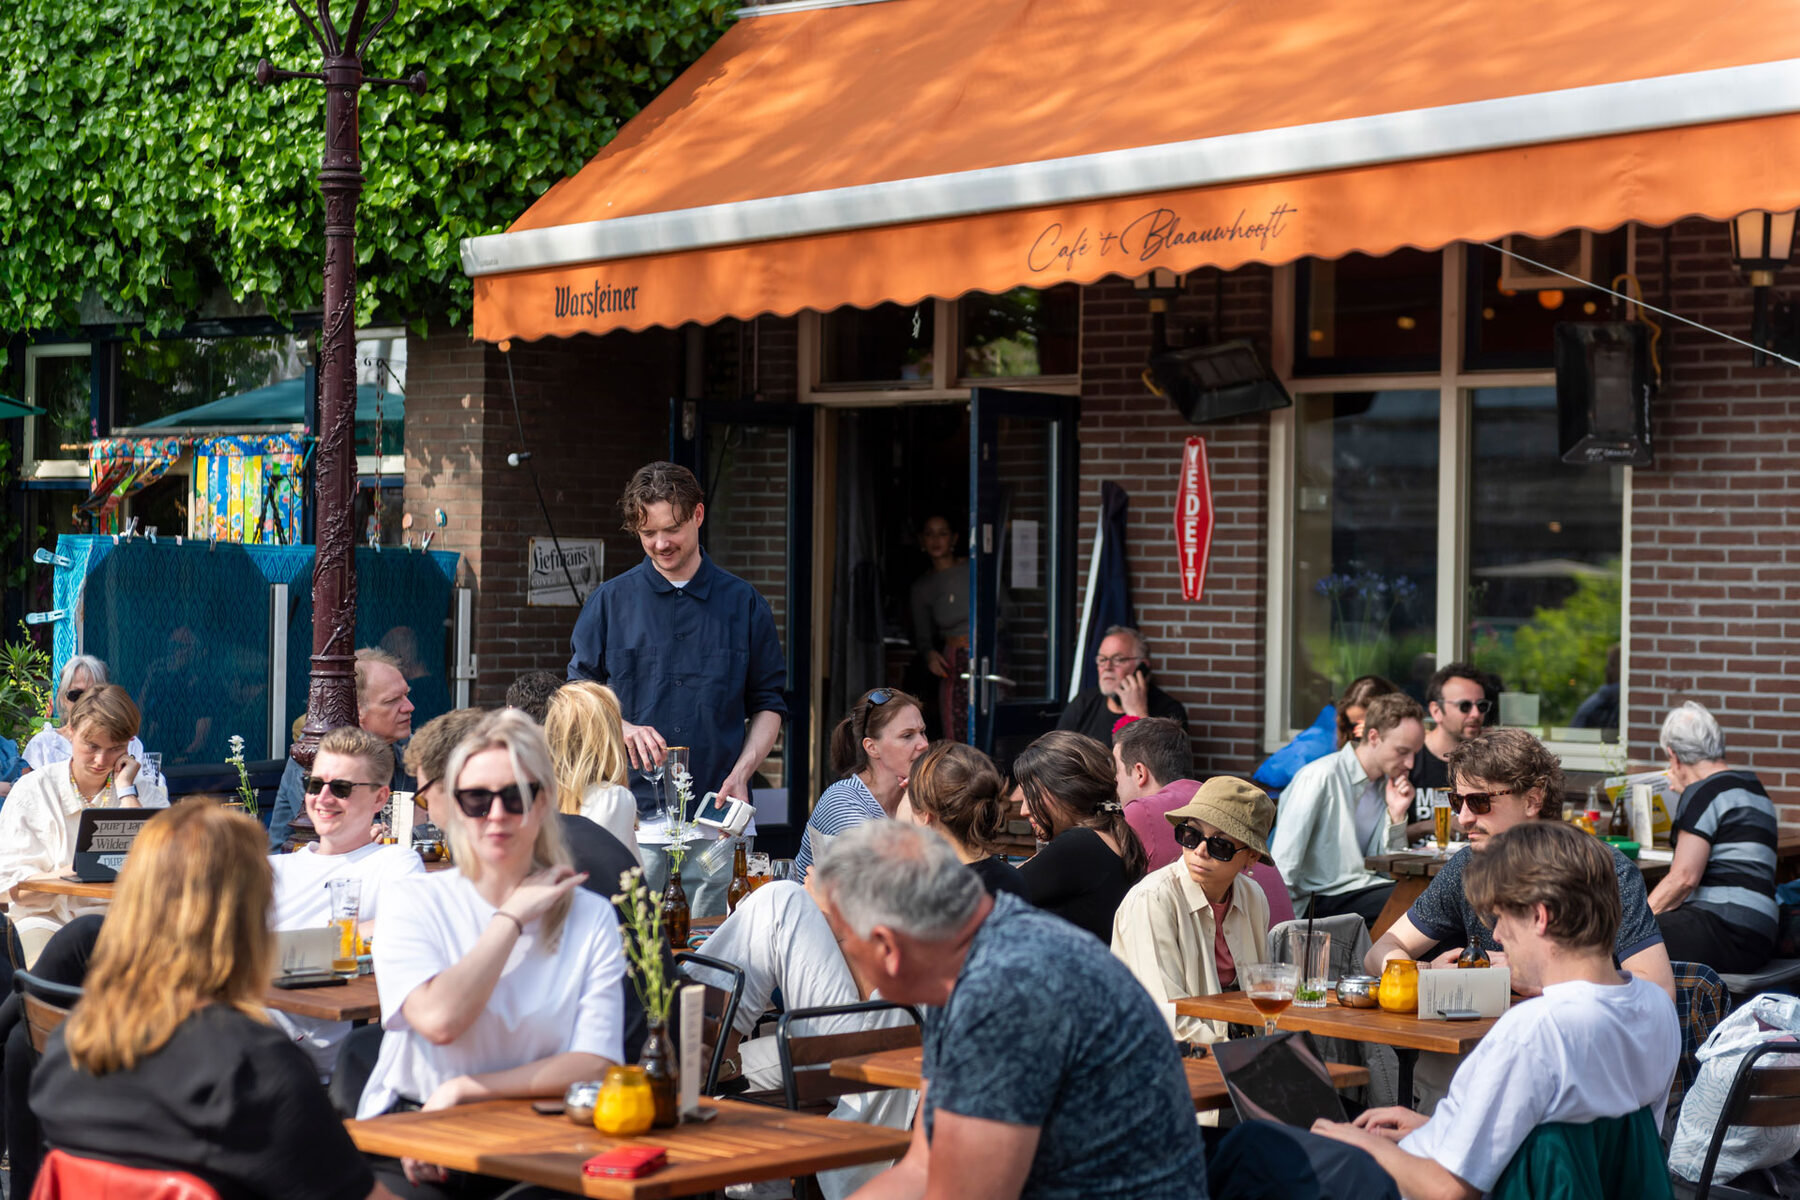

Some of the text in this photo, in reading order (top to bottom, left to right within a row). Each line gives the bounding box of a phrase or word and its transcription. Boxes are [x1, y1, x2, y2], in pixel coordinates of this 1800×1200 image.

[1028, 223, 1090, 272] Café
[1120, 203, 1297, 262] Blaauwhooft
[555, 279, 638, 319] Warsteiner
[1184, 445, 1200, 590] VEDETT
[533, 546, 588, 575] Liefmans
[96, 838, 129, 849] Wilder
[99, 822, 126, 833] Land
